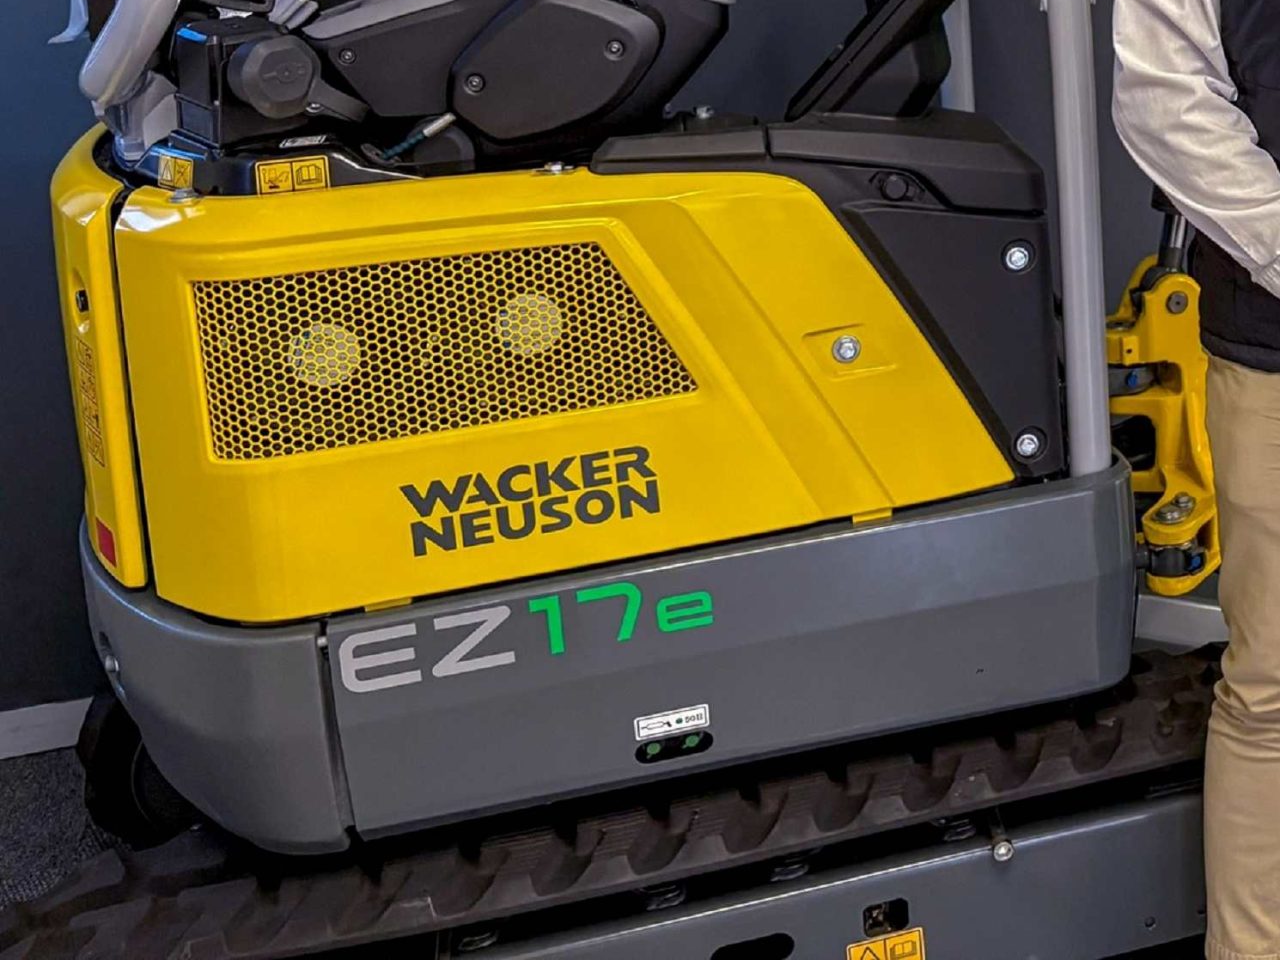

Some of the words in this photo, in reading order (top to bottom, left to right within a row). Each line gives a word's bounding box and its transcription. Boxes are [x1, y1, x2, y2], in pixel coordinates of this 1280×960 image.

[398, 445, 658, 518] WACKER
[410, 479, 661, 557] NEUSON
[338, 581, 714, 694] EZ17e
